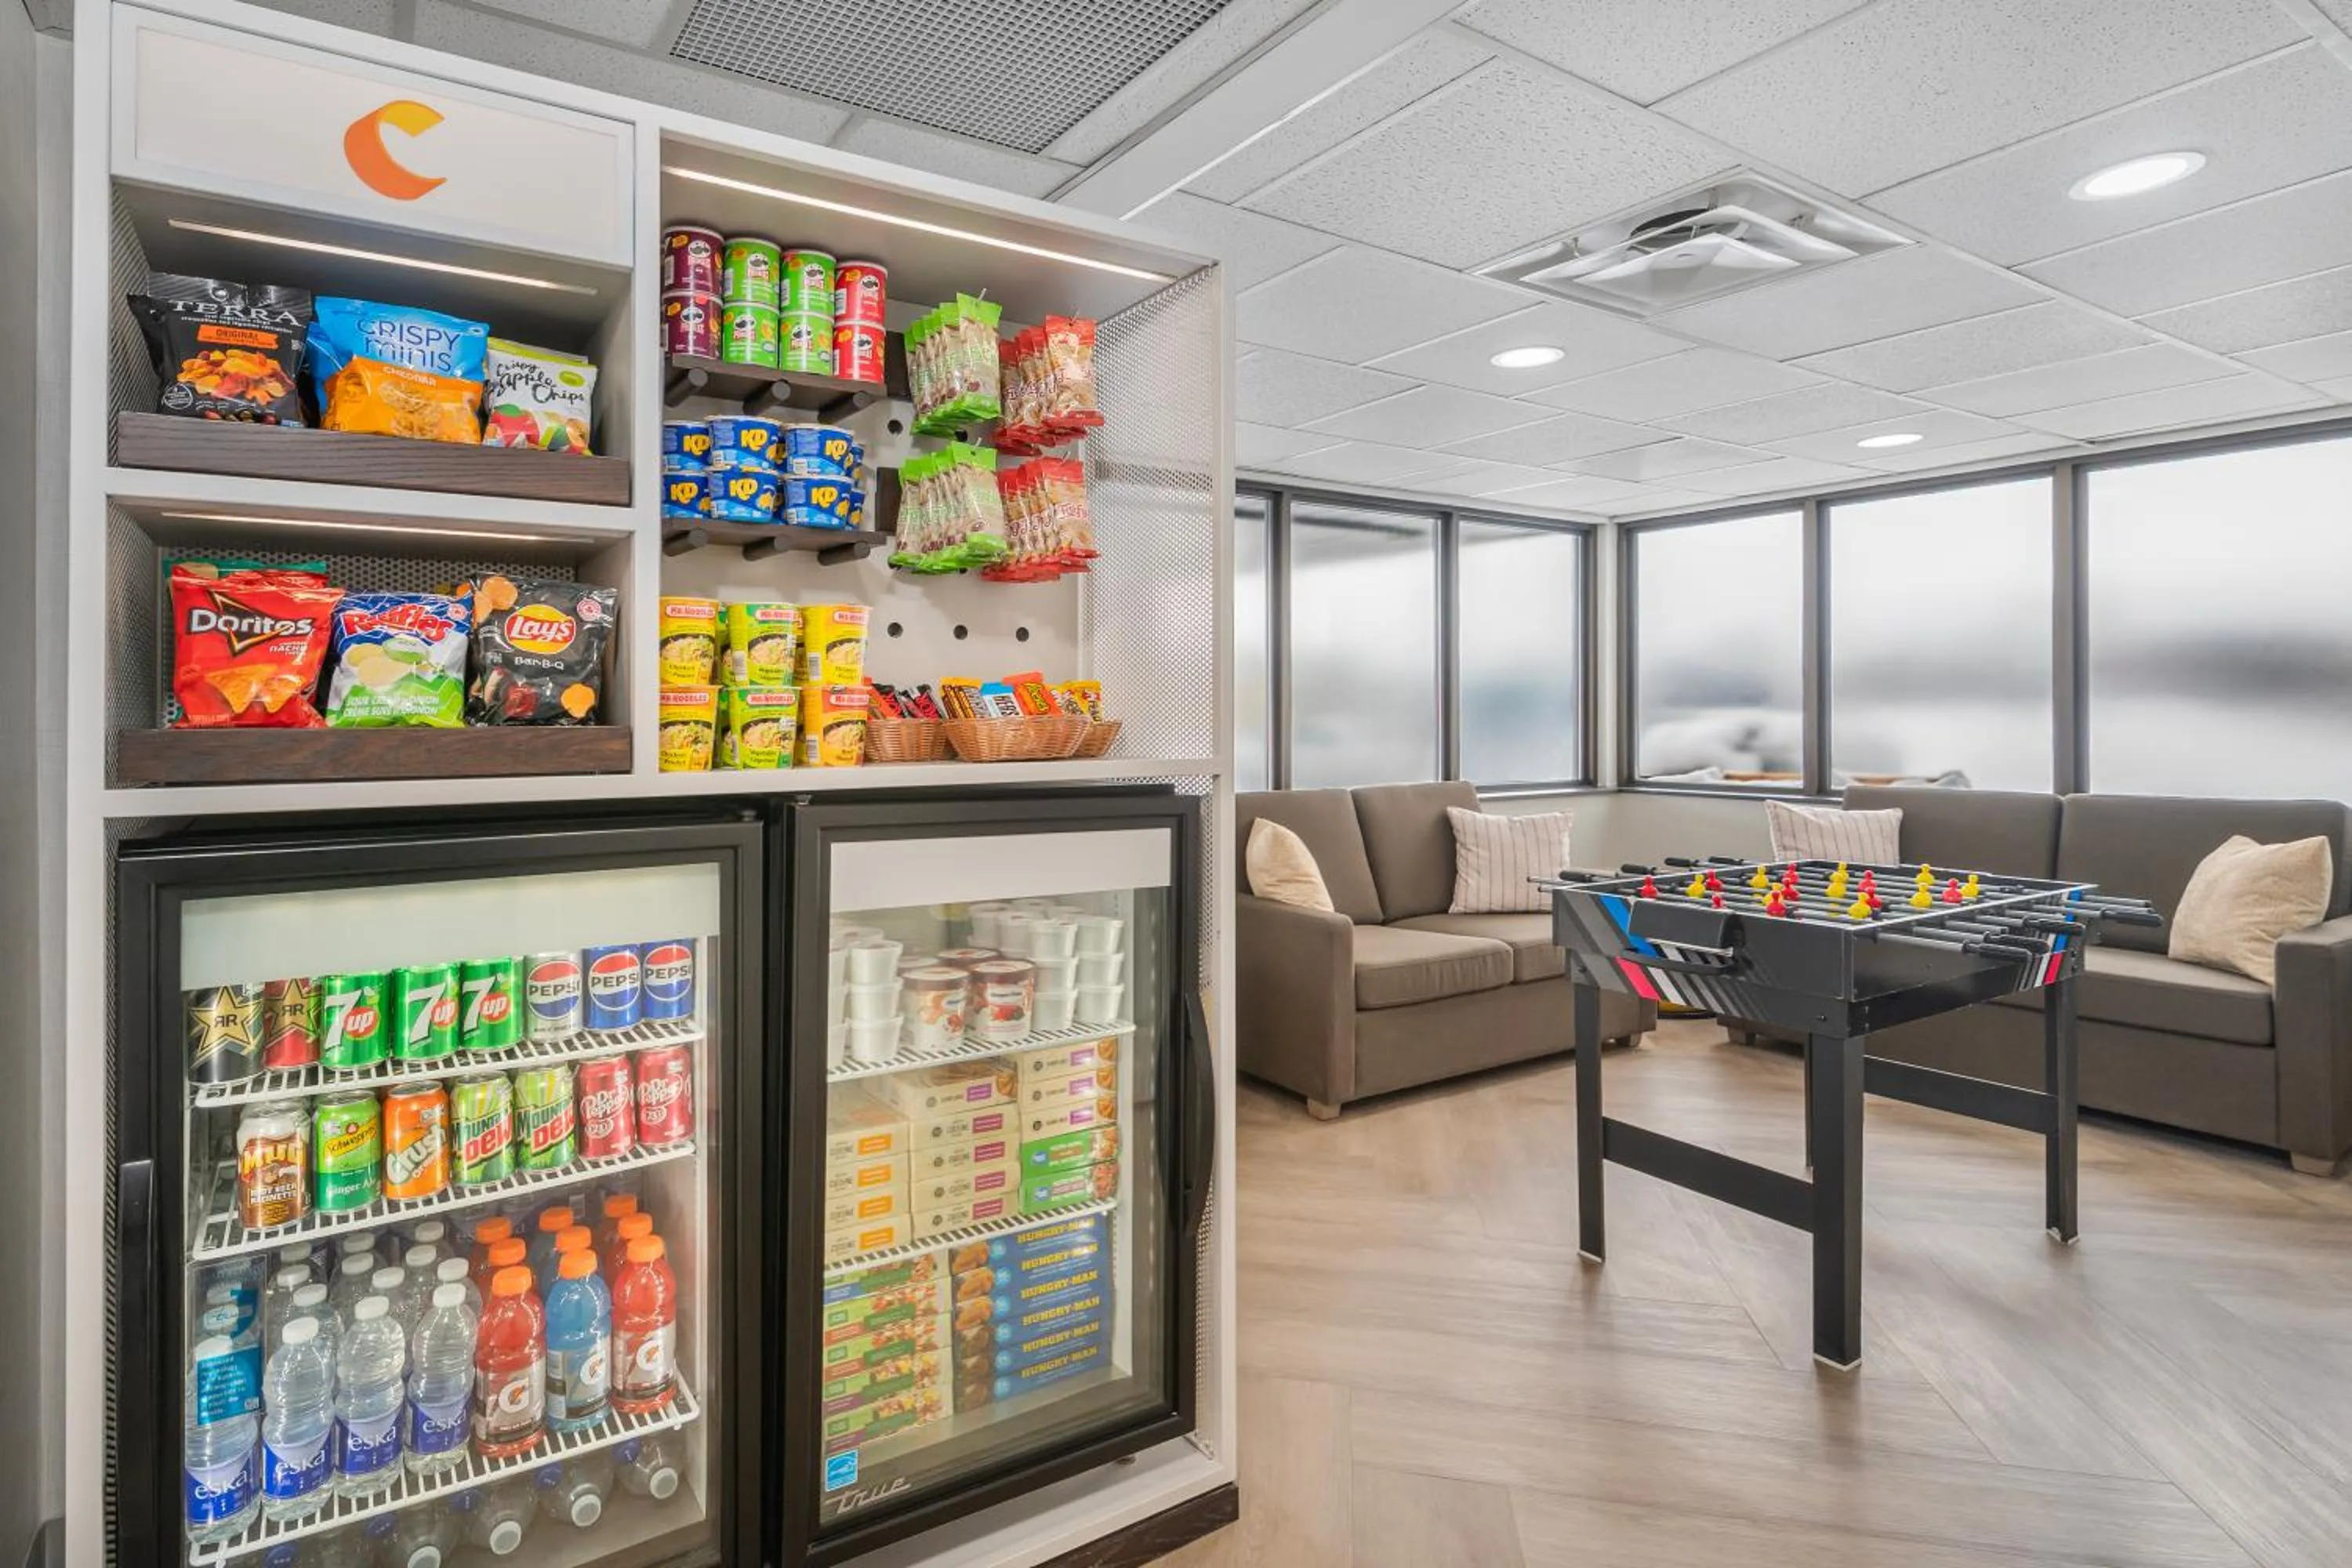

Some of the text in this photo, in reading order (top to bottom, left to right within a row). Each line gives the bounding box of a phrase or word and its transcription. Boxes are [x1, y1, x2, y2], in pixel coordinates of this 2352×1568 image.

[168, 300, 306, 328] TERRA
[358, 318, 460, 351] CRISPY
[190, 608, 313, 636] Doritos
[343, 604, 455, 642] Ruffles
[510, 615, 572, 641] Lay's
[591, 972, 639, 988] PEPSI
[645, 965, 691, 979] PEPSI
[528, 982, 580, 997] PEPSI
[387, 1123, 447, 1184] Crush
[422, 1408, 466, 1433] eska
[350, 1425, 397, 1451] eska
[275, 1450, 325, 1476] eska
[194, 1468, 247, 1500] eska
